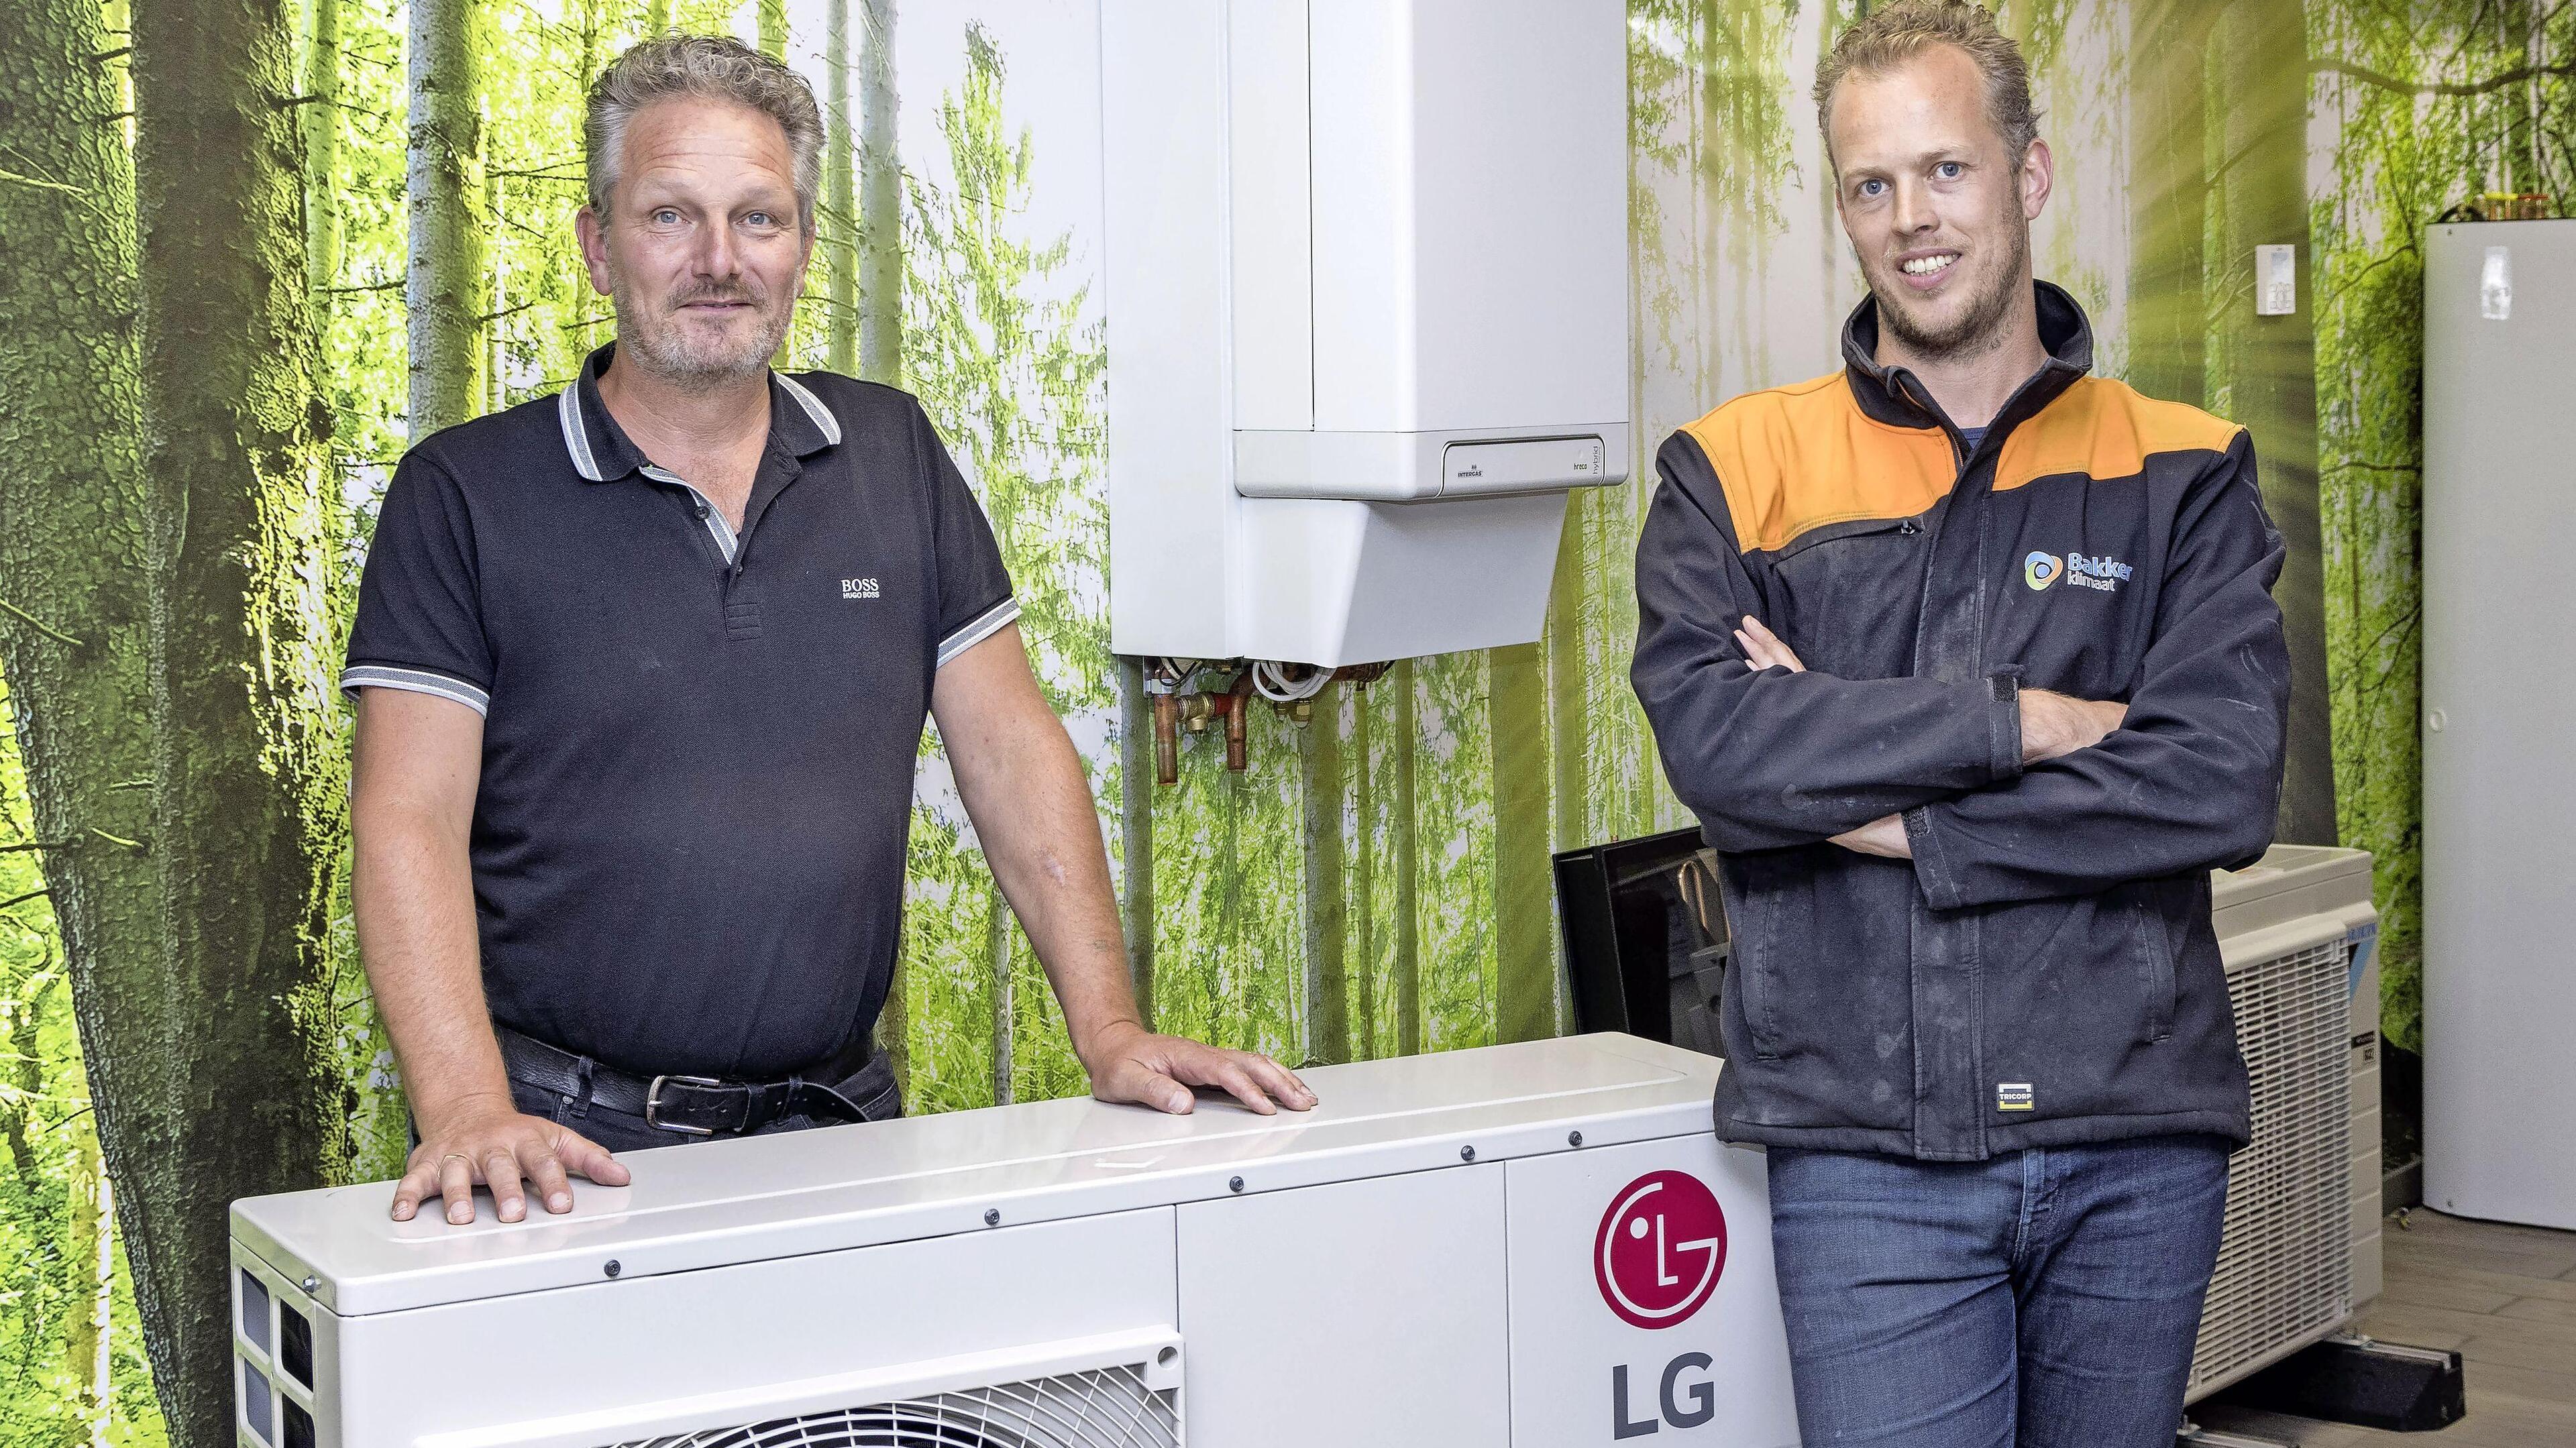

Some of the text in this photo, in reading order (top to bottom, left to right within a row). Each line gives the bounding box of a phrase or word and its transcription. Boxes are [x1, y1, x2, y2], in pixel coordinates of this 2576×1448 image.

[2068, 553, 2133, 581] Bakker
[841, 578, 879, 592] BOSS
[2067, 571, 2115, 592] klimaat
[863, 591, 879, 599] BOSS
[1613, 1351, 1715, 1441] LG
